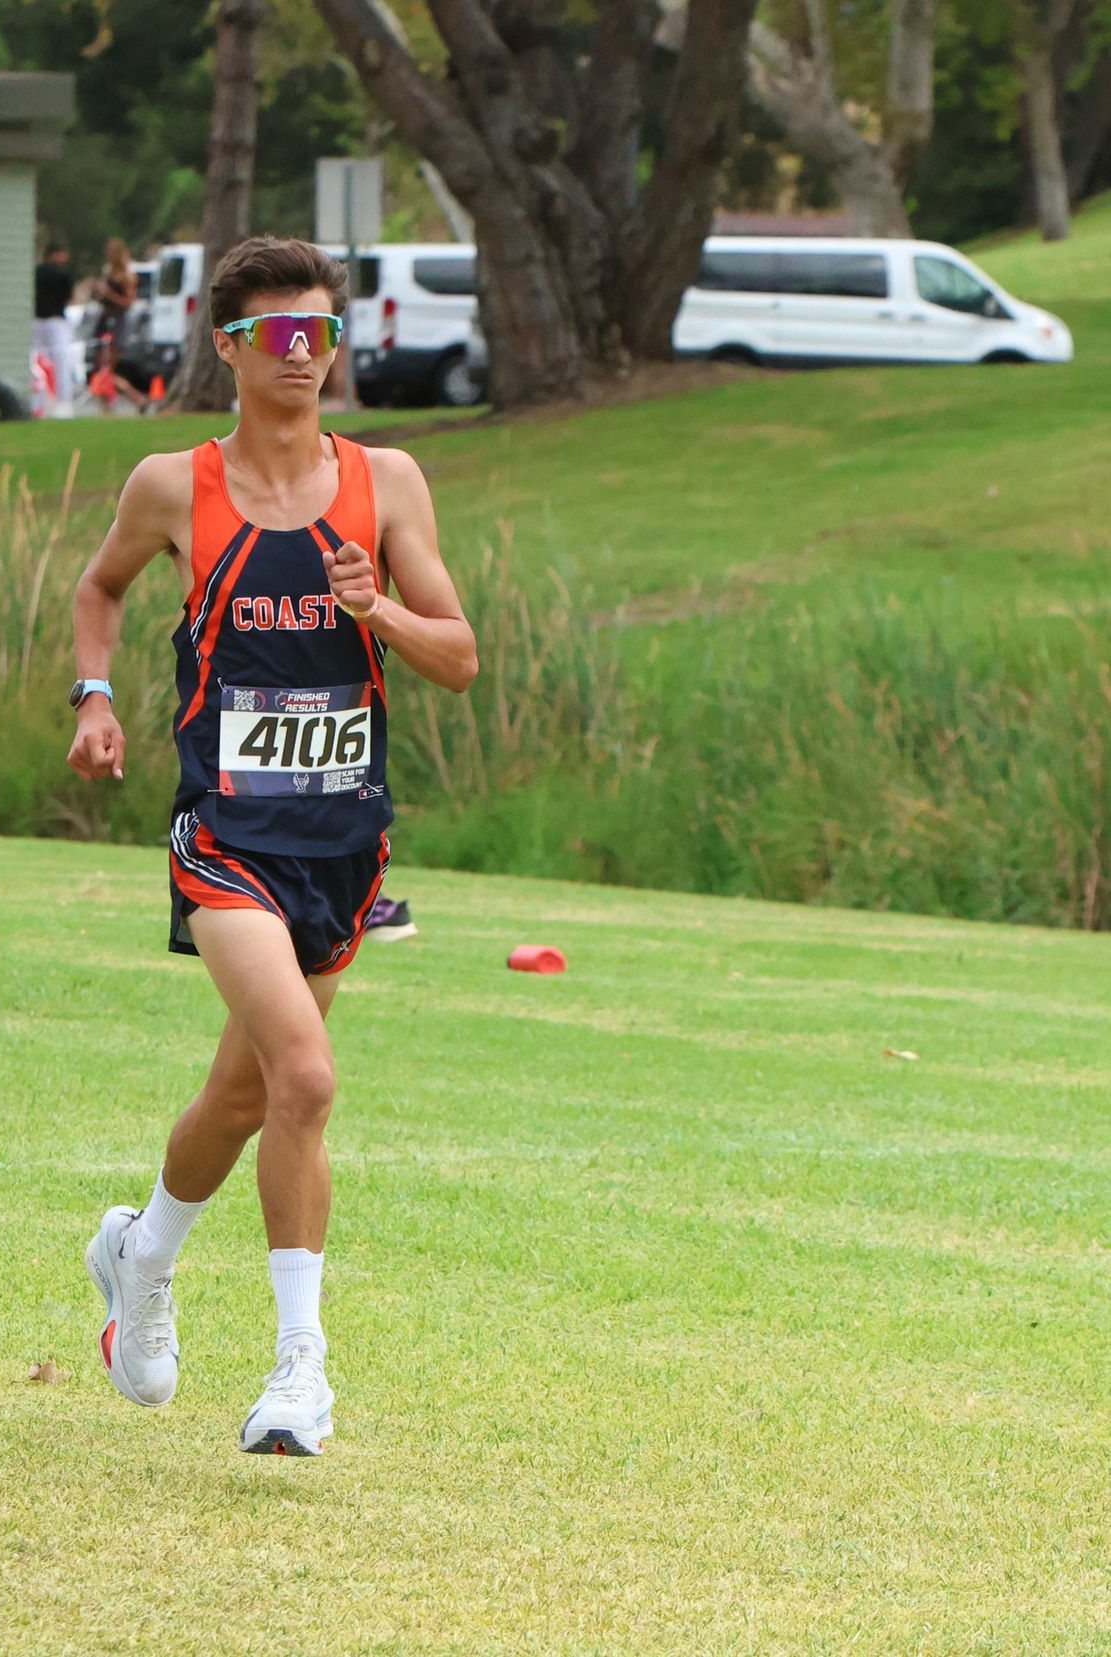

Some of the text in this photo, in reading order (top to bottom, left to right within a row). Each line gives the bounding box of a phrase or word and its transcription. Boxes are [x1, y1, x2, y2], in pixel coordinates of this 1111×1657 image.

[232, 594, 338, 632] COAST
[284, 703, 328, 713] RESULTS
[287, 692, 330, 702] FINISHED
[238, 711, 368, 768] 4106
